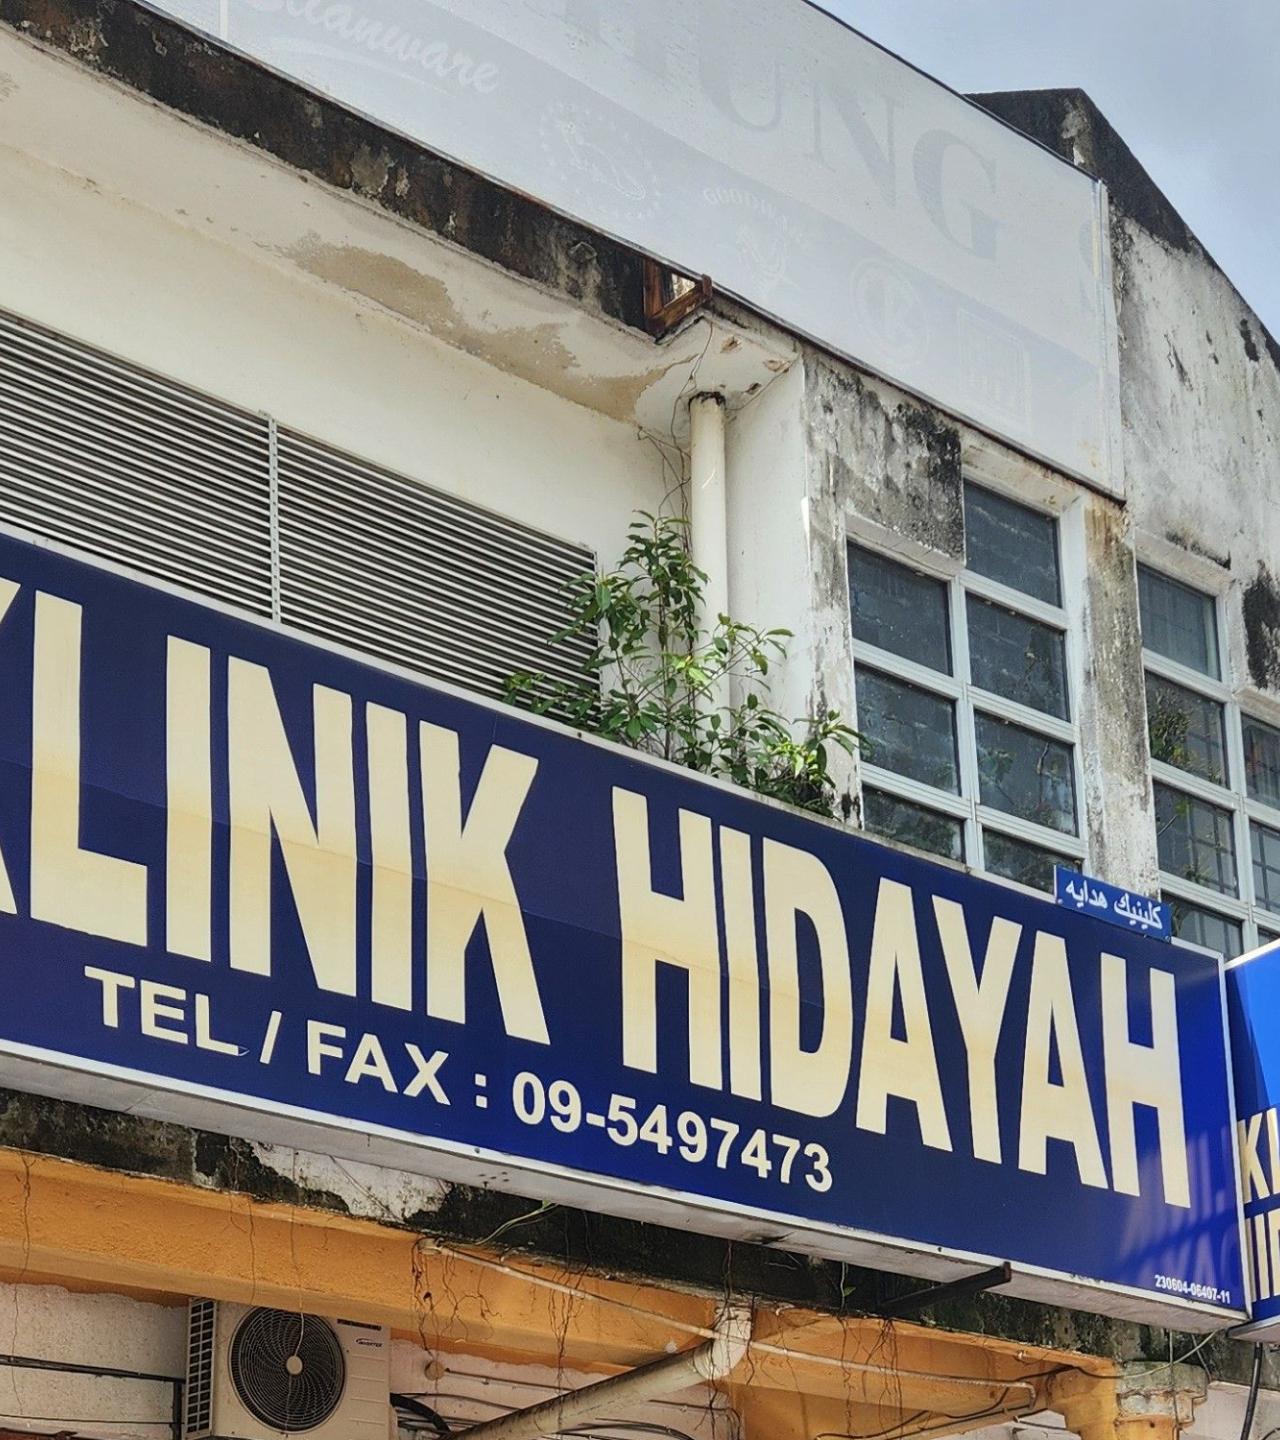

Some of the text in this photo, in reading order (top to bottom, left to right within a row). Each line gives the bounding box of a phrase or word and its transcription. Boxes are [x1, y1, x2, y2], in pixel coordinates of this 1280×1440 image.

[84, 966, 242, 1057] TEL
[307, 1019, 452, 1106] FAX
[512, 1071, 834, 1193] 09-5497473
[612, 786, 1191, 1208] HIDAYAH
